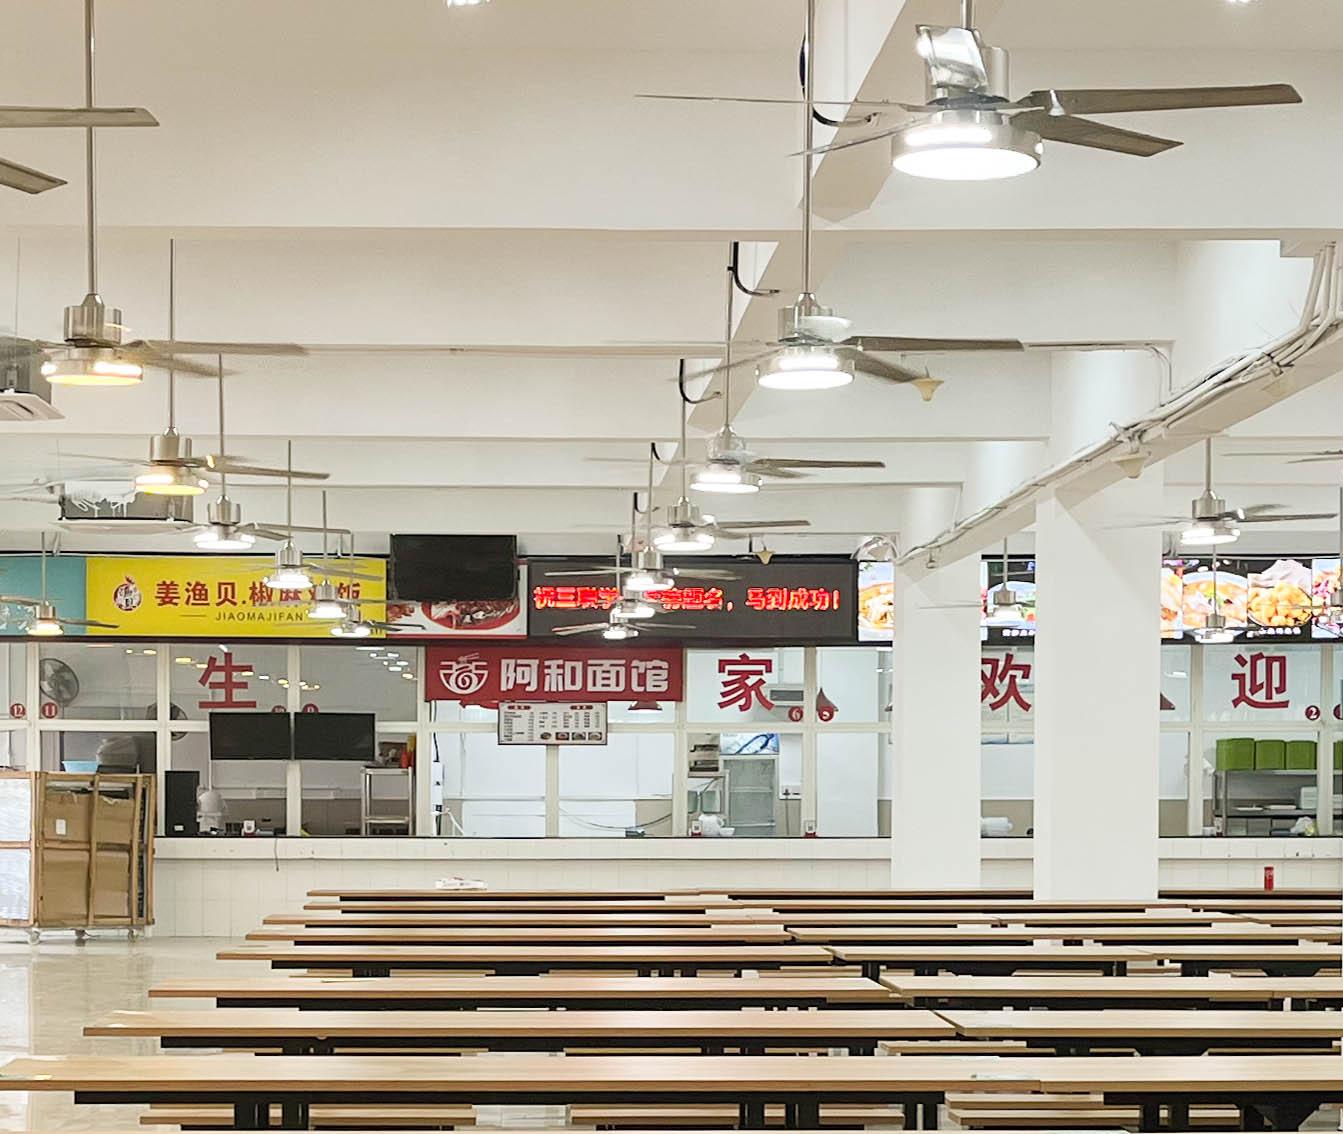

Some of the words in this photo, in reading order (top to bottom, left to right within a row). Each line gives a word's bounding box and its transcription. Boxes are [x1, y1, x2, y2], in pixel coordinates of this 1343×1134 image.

[216, 611, 304, 622] JIAOMAJIFAN
[198, 651, 257, 709] 生
[717, 653, 775, 712] 家
[981, 653, 1032, 712] 欢
[1231, 652, 1290, 709] 迎
[500, 658, 669, 693] 阿和面馆
